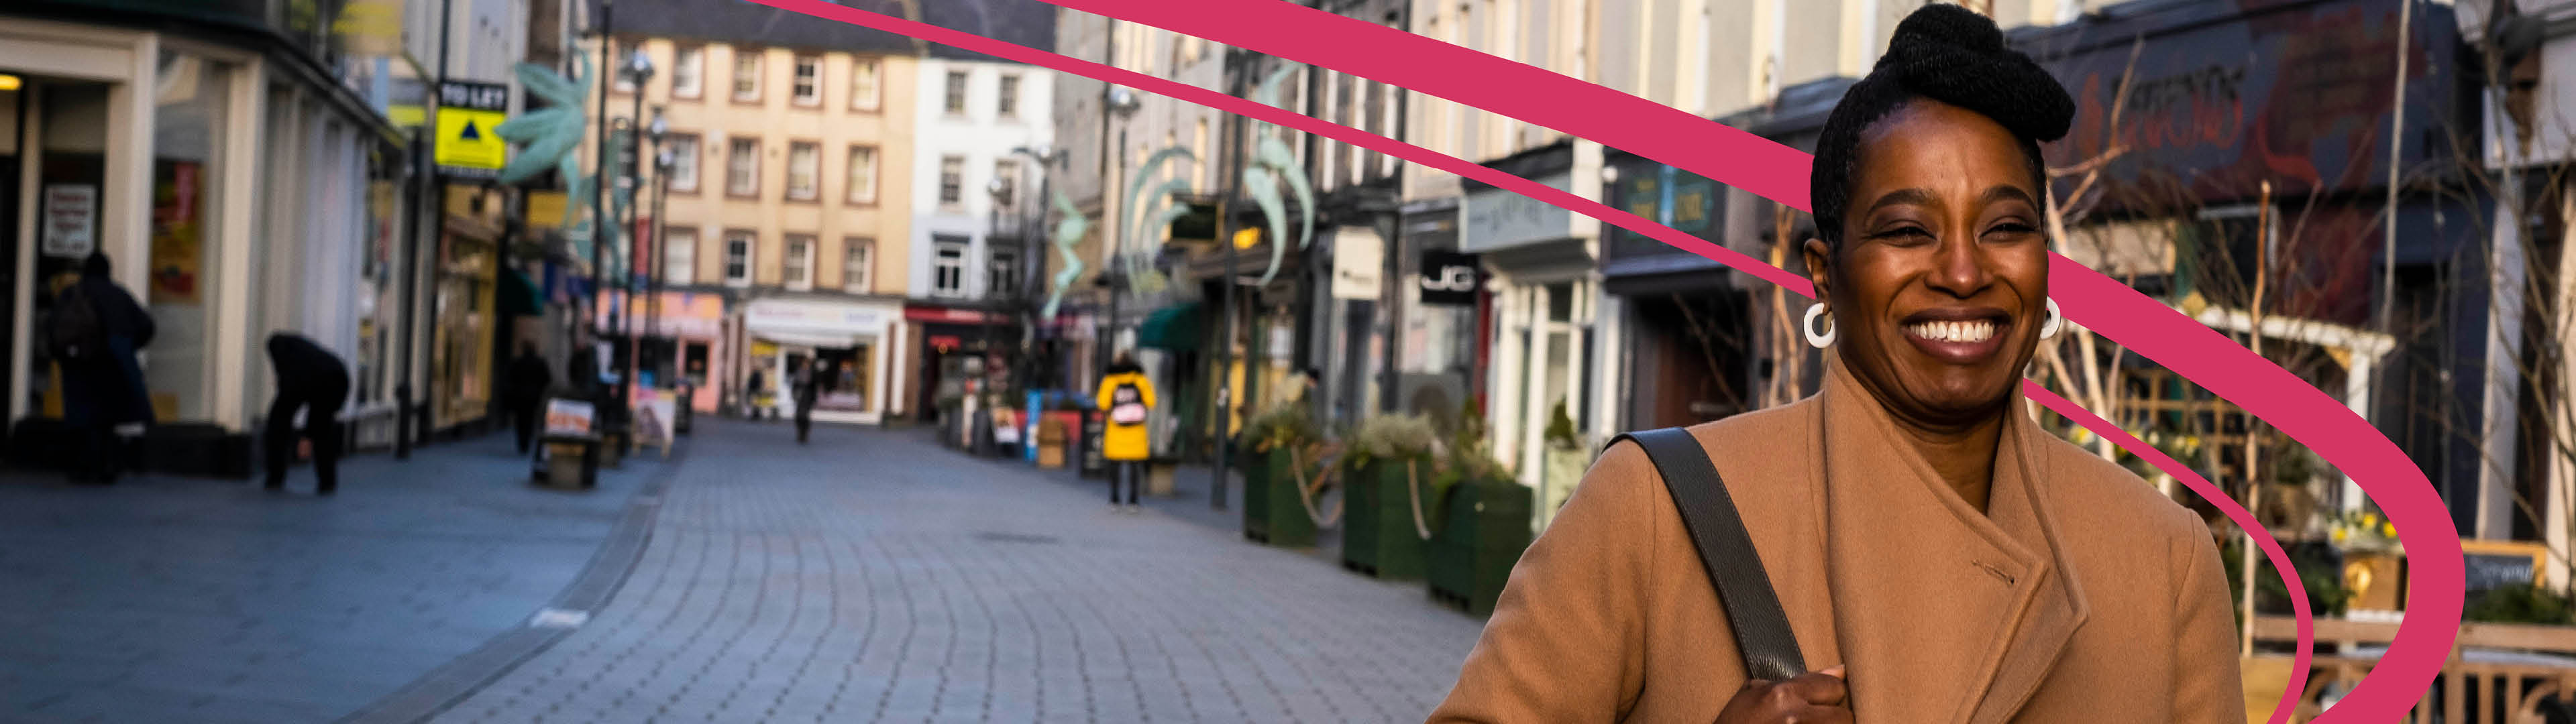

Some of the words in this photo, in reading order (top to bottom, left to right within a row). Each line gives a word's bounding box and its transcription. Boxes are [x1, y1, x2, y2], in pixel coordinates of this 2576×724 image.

[442, 83, 468, 105] TO
[470, 86, 504, 107] LET
[1421, 265, 1477, 291] JG
